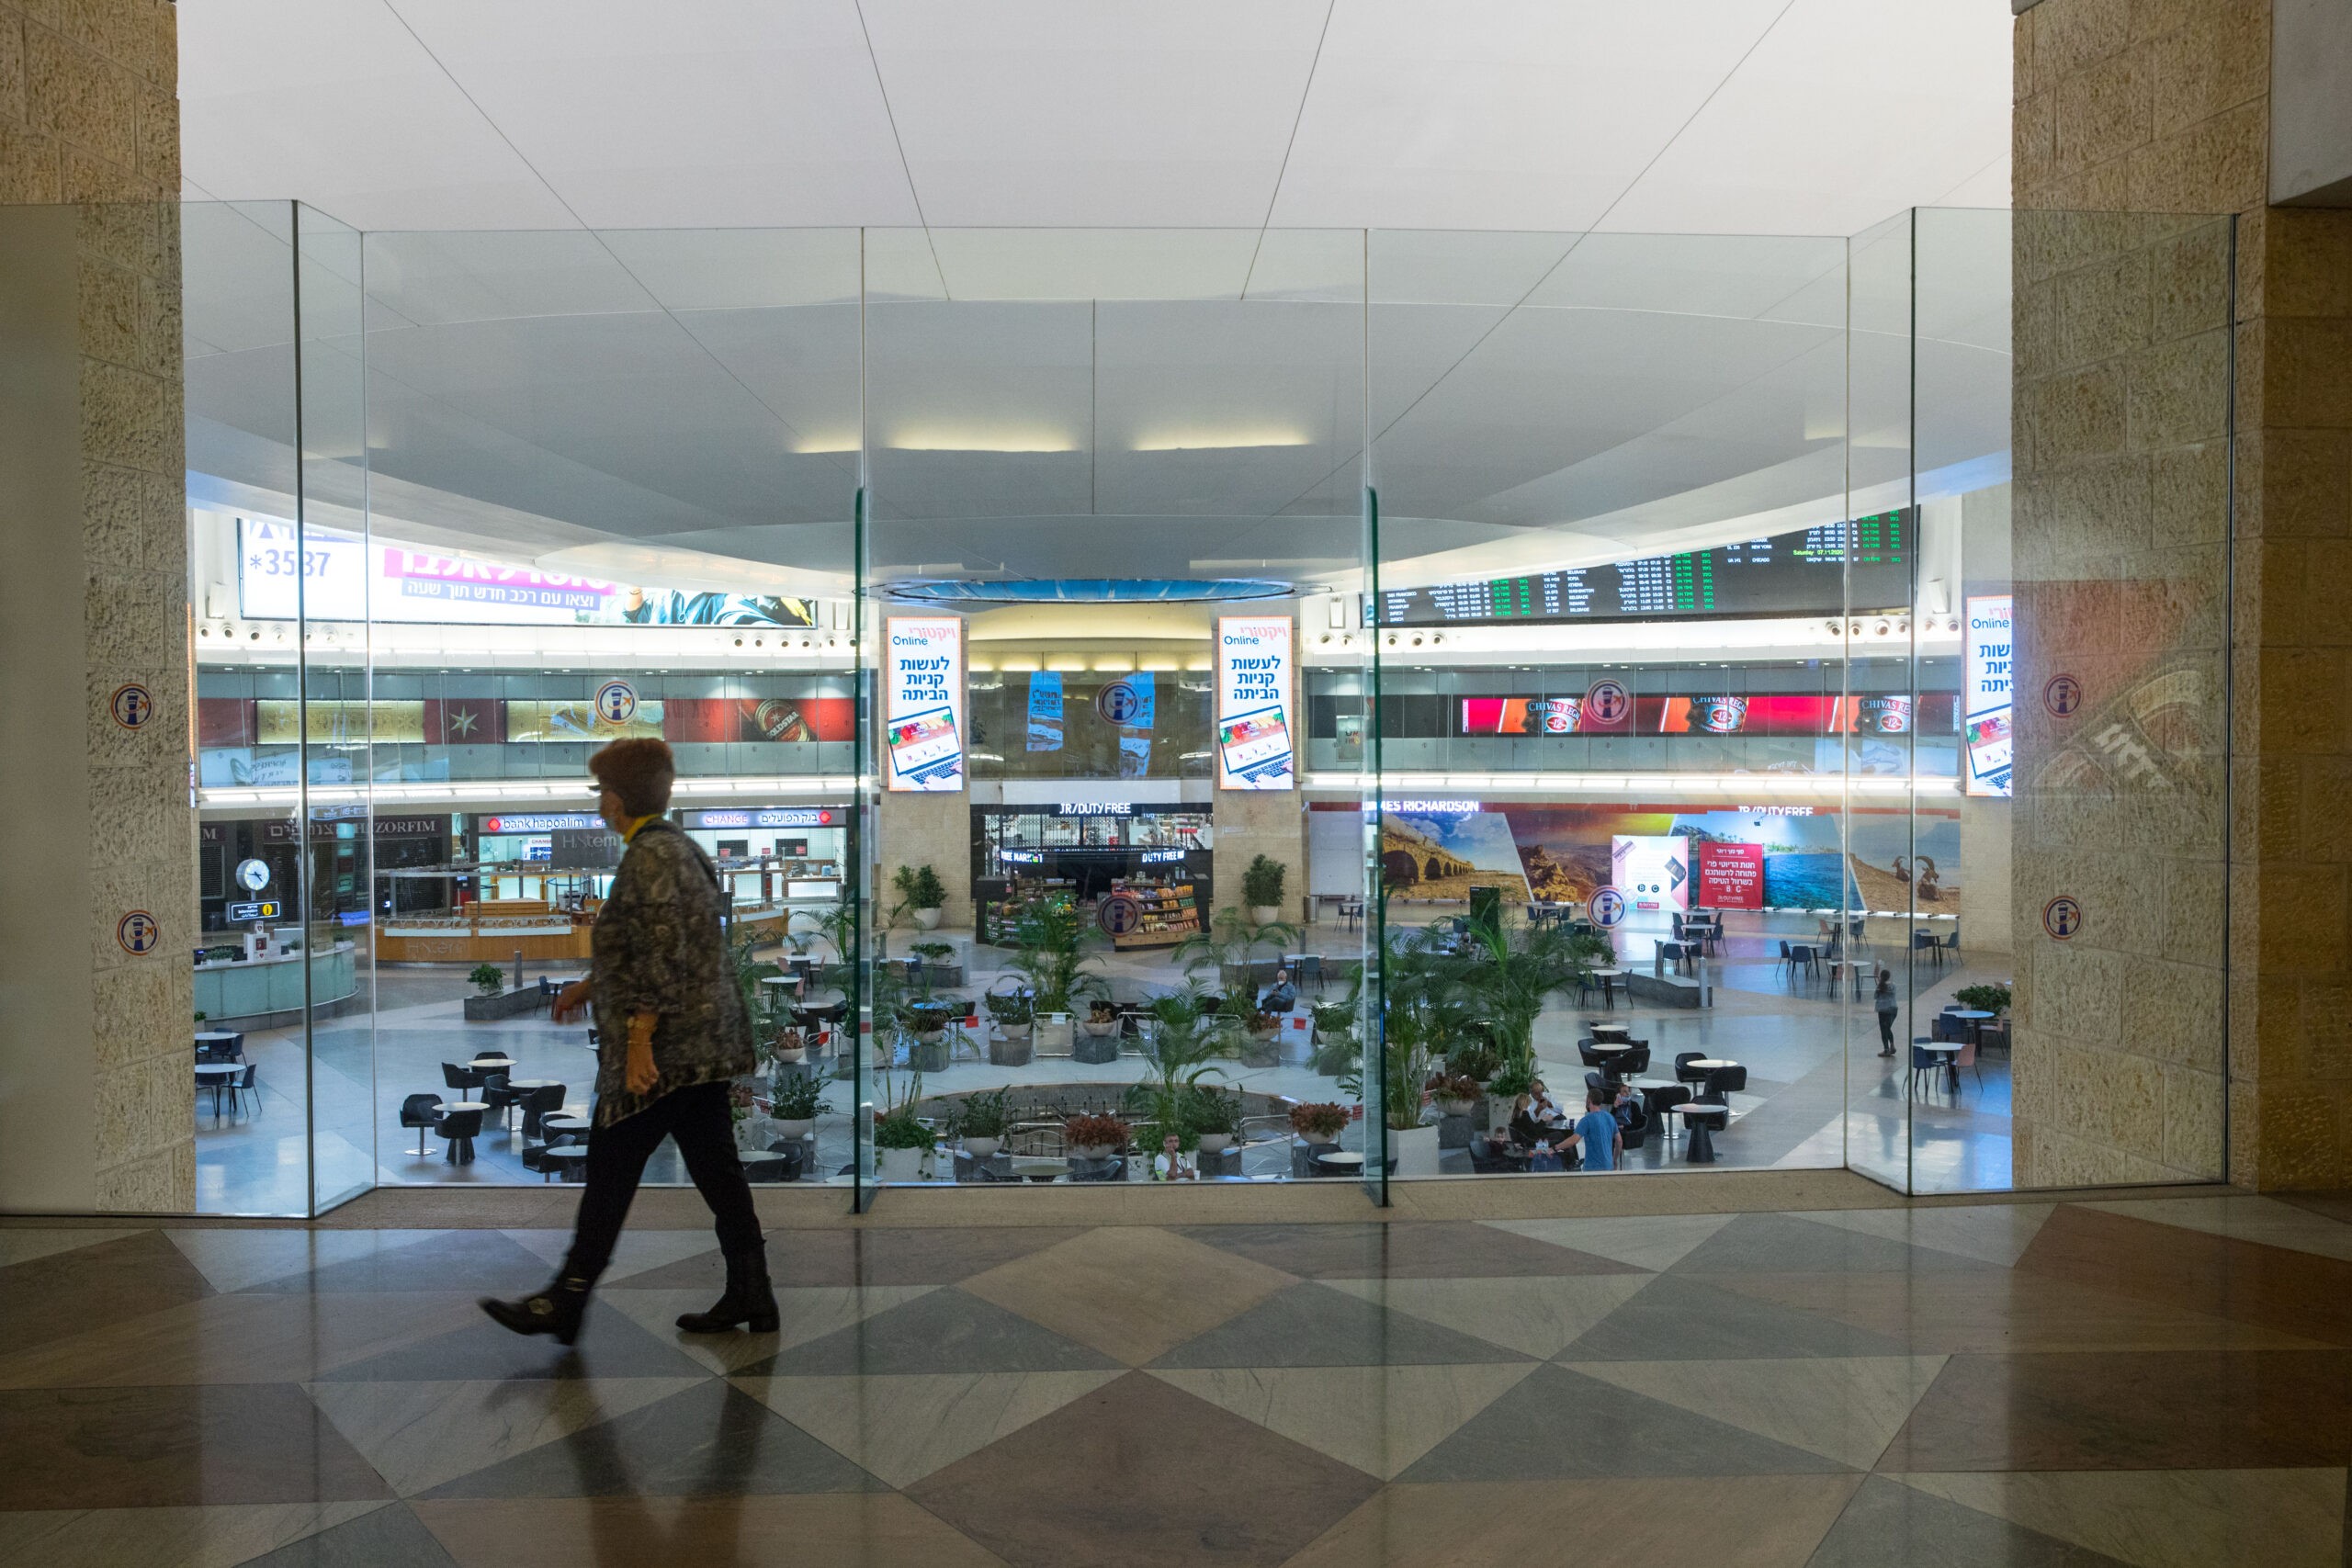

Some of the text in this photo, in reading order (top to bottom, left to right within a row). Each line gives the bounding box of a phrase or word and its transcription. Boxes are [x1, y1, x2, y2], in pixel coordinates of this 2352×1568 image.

[408, 581, 594, 608] וצאו עם רכב חדש תוך שעה
[1972, 618, 2009, 629] Online
[893, 636, 928, 646] Online
[1224, 636, 1259, 645] Online
[899, 656, 950, 671] לעשות
[1231, 655, 1281, 670] לעשות
[906, 674, 944, 689] קניות
[1237, 673, 1275, 688] קניות
[902, 690, 948, 701] הביתה
[1234, 688, 1279, 700] הביתה
[1528, 702, 1562, 713] CHIVAS
[1861, 700, 1897, 711] CHIVAS
[1403, 800, 1478, 812] RICHARDSON
[503, 818, 530, 829] bank
[533, 818, 583, 829] hapoalim
[706, 815, 747, 824] CHANGE
[762, 814, 818, 824] בנק הפועלים
[1142, 852, 1161, 863] DUTY
